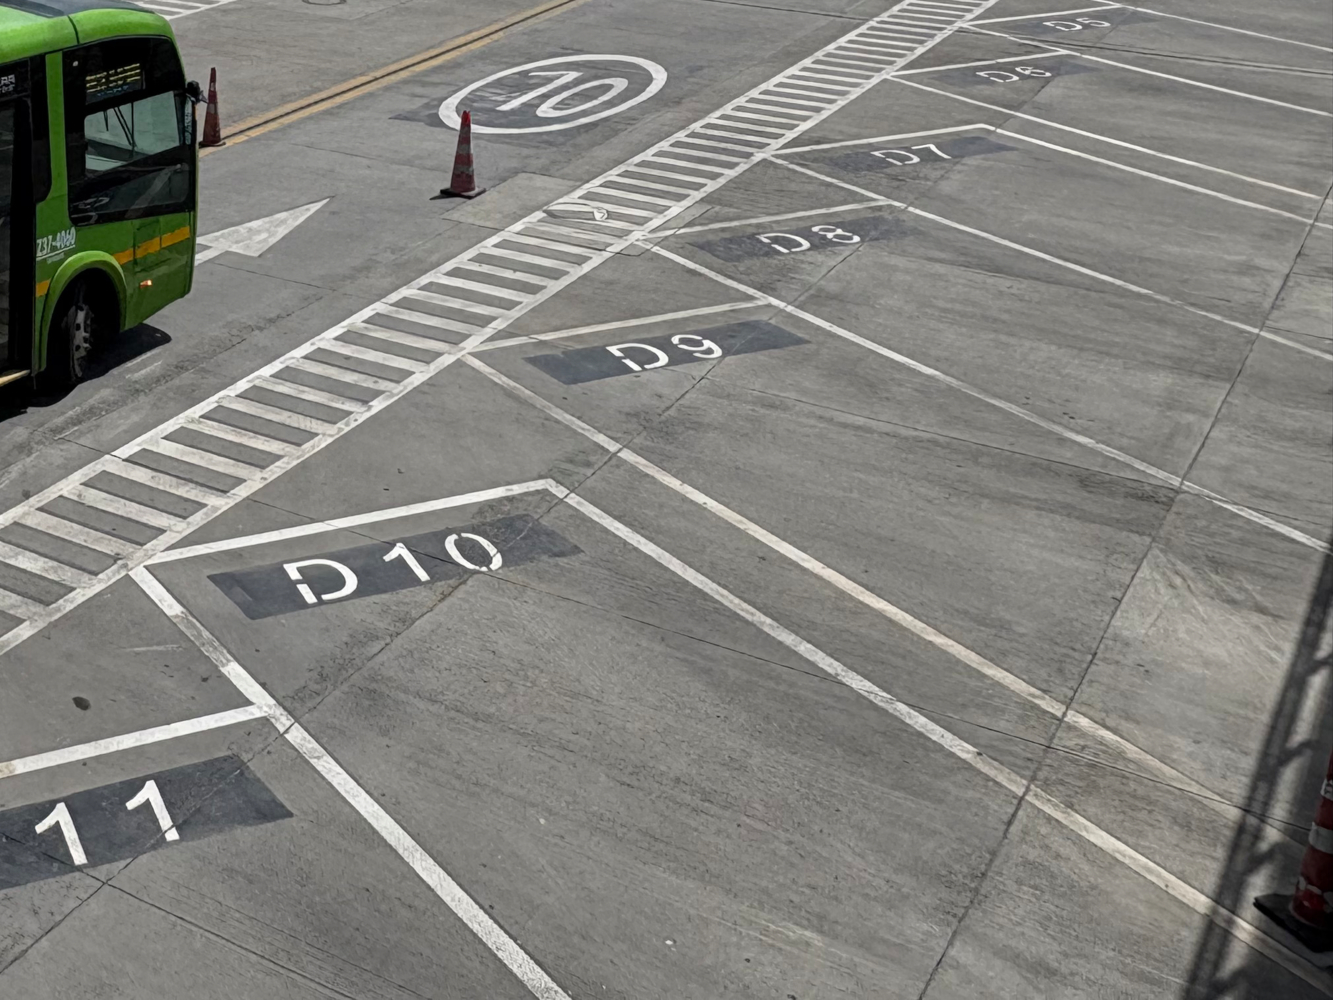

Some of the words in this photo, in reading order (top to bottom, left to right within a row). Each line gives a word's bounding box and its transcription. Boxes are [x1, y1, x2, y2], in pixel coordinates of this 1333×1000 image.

[1042, 17, 1113, 33] D5
[975, 66, 1053, 83] D6
[870, 143, 952, 166] D7
[756, 224, 862, 254] D8
[605, 334, 723, 372] D9
[282, 532, 504, 605] D10
